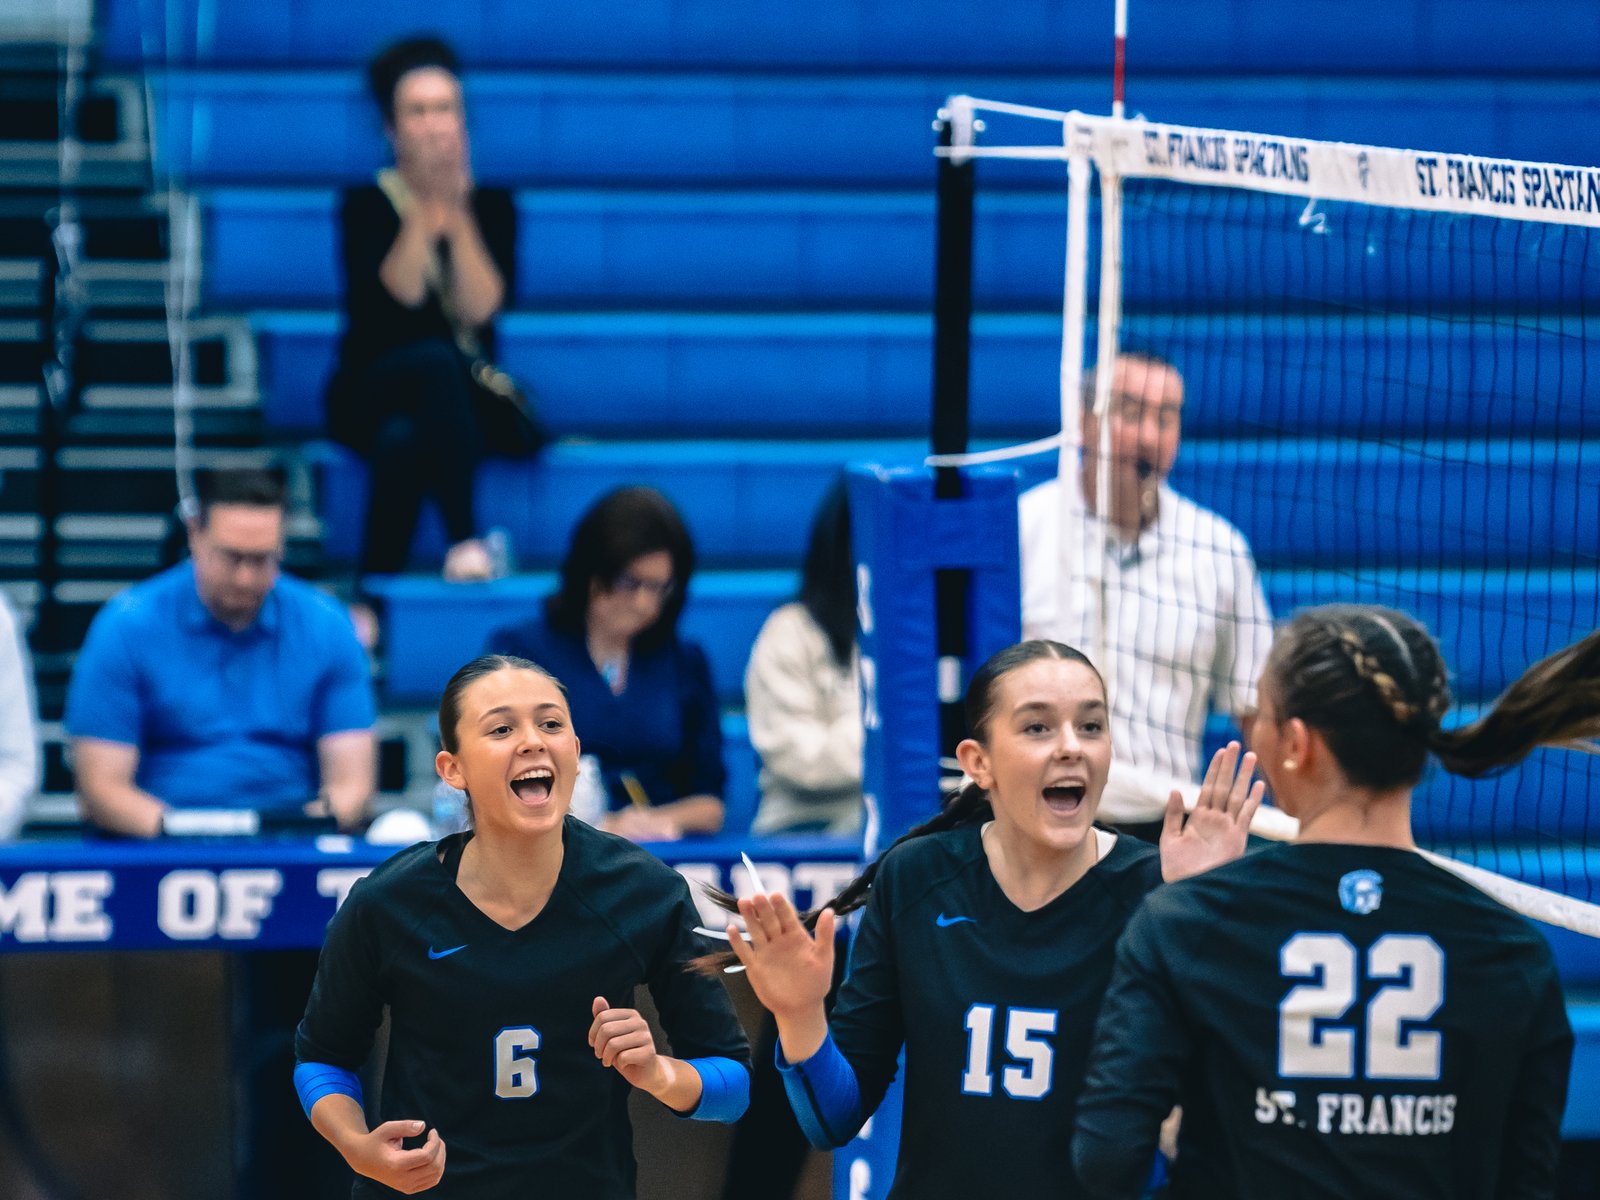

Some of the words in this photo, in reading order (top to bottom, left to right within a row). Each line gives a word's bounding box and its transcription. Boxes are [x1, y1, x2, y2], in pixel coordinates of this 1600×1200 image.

[1415, 156, 1442, 197] ST.
[1447, 159, 1516, 205] FRANCIS
[156, 868, 285, 941] OF
[1277, 930, 1446, 1082] 22
[492, 1024, 543, 1100] 6
[961, 1002, 1059, 1102] 15
[1316, 1092, 1458, 1137] FRANCIS
